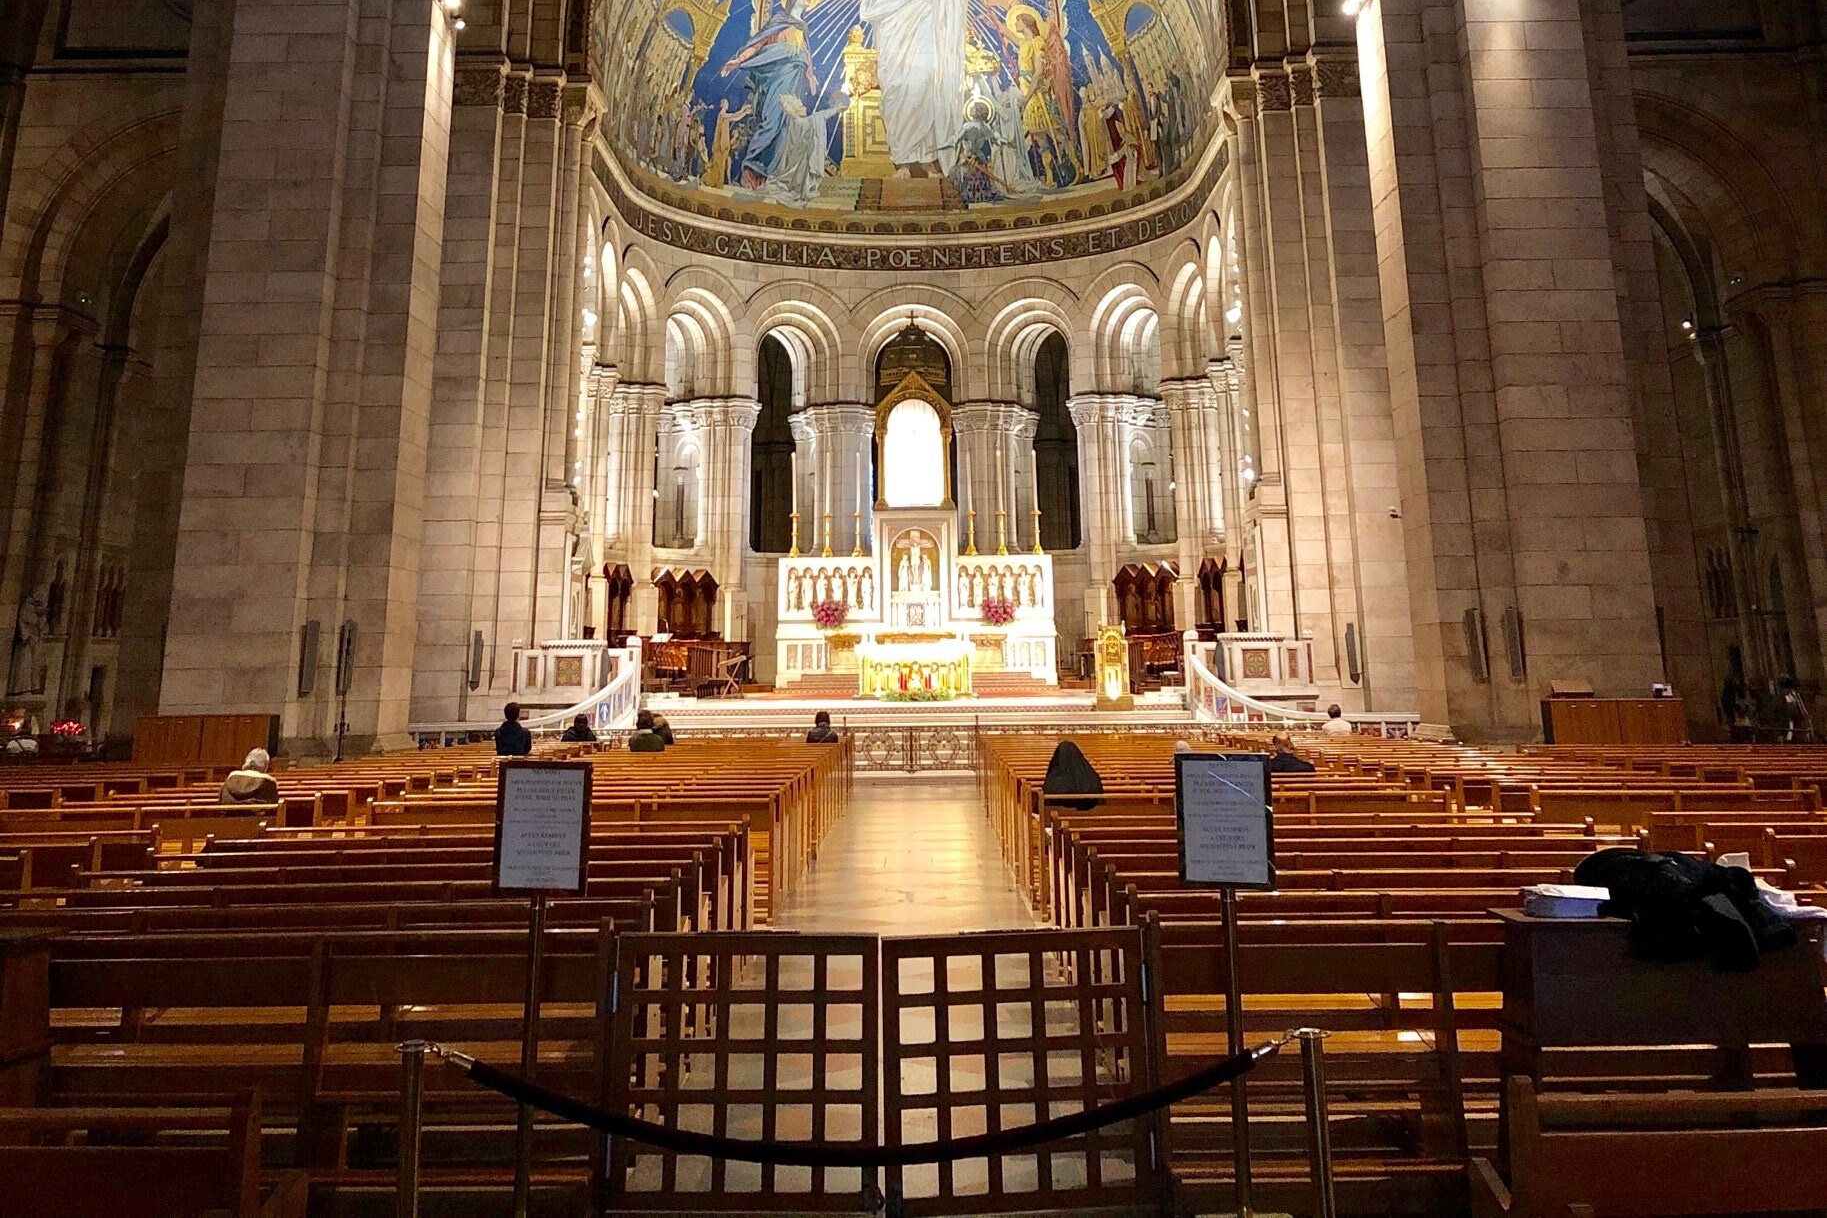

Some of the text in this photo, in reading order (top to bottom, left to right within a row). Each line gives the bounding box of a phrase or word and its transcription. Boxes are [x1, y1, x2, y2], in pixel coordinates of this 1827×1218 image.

[635, 212, 694, 245] JESV
[715, 234, 838, 266] GALLIA
[1088, 227, 1120, 253] ET
